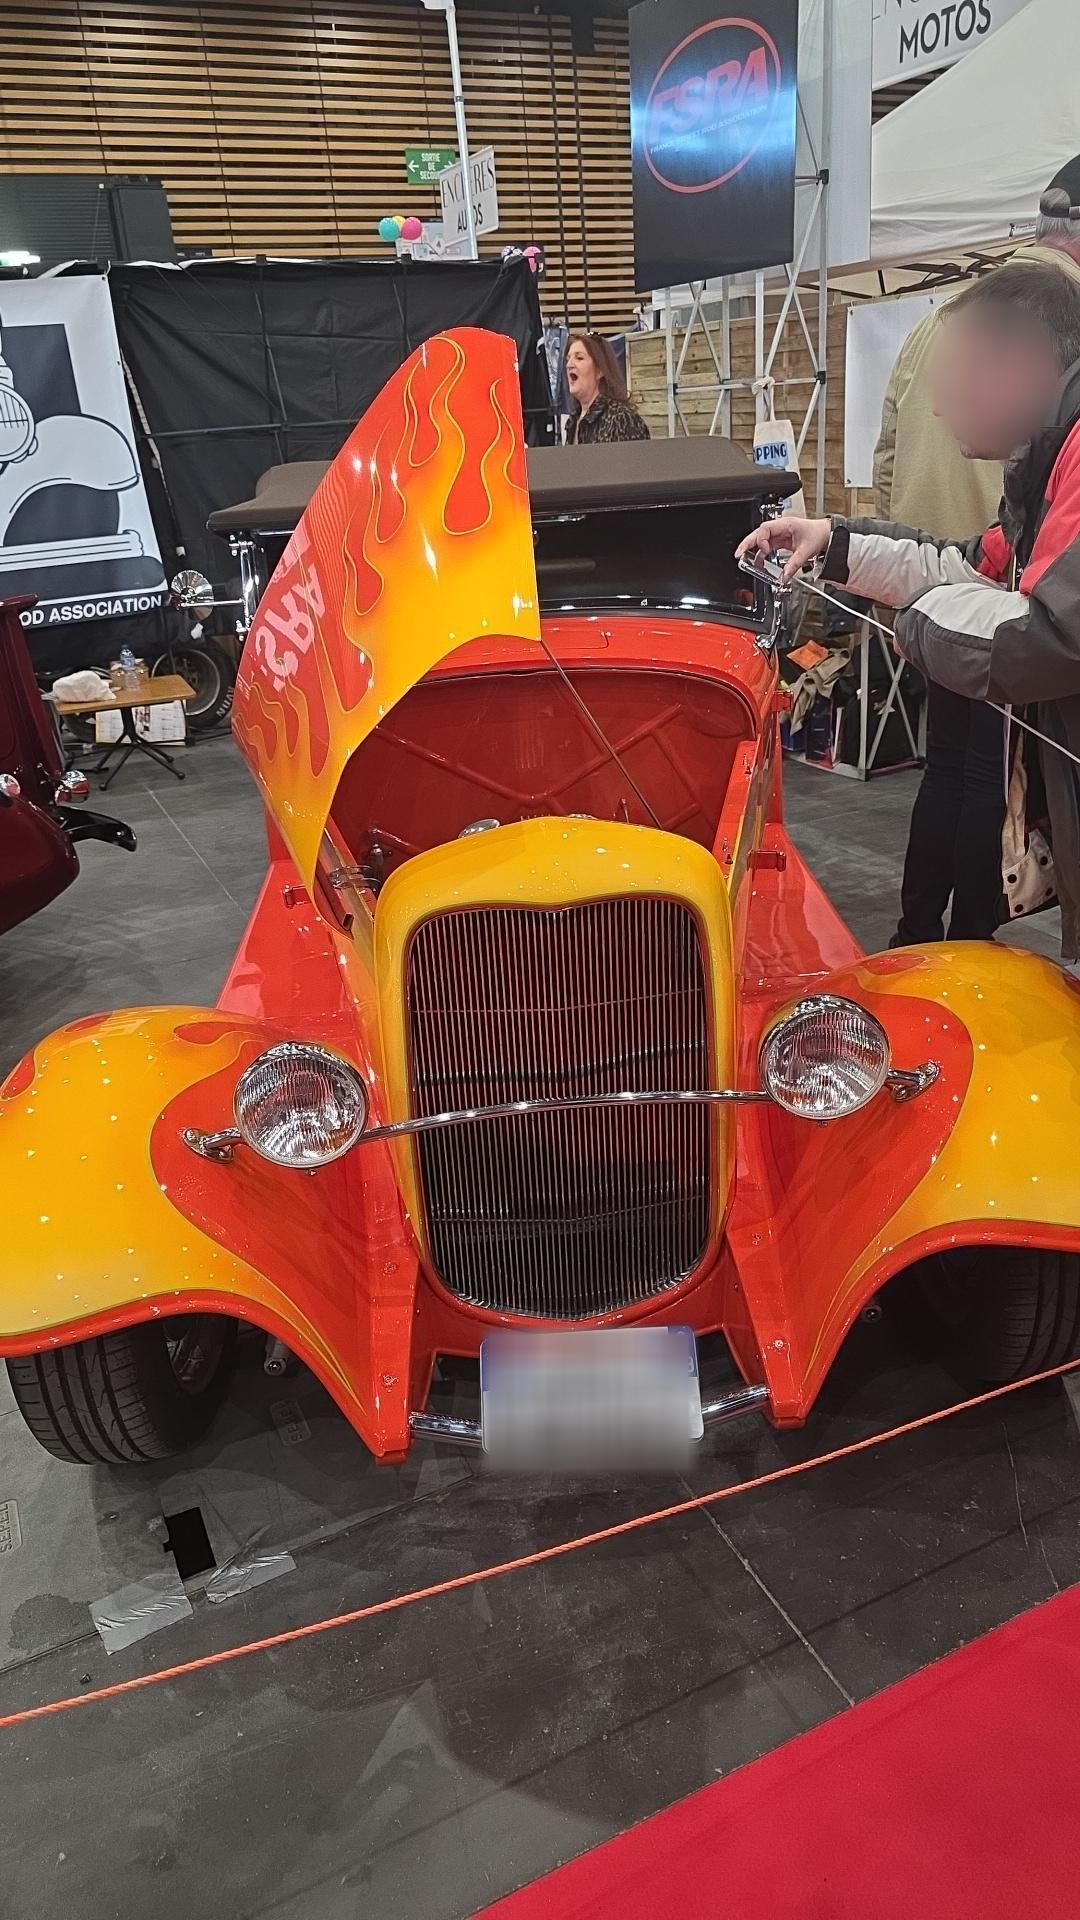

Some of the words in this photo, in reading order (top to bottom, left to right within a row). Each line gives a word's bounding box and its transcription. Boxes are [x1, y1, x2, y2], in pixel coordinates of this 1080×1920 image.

[899, 0, 991, 63] MOTOS
[651, 46, 768, 144] FSRA
[421, 153, 441, 162] SORTIE
[427, 162, 436, 171] DE
[420, 171, 441, 180] SECOU
[441, 158, 495, 208] ENCRES
[457, 202, 483, 234] AUOS
[754, 443, 787, 462] PPING
[19, 609, 45, 627] OD
[48, 594, 162, 623] ASSOCIATION
